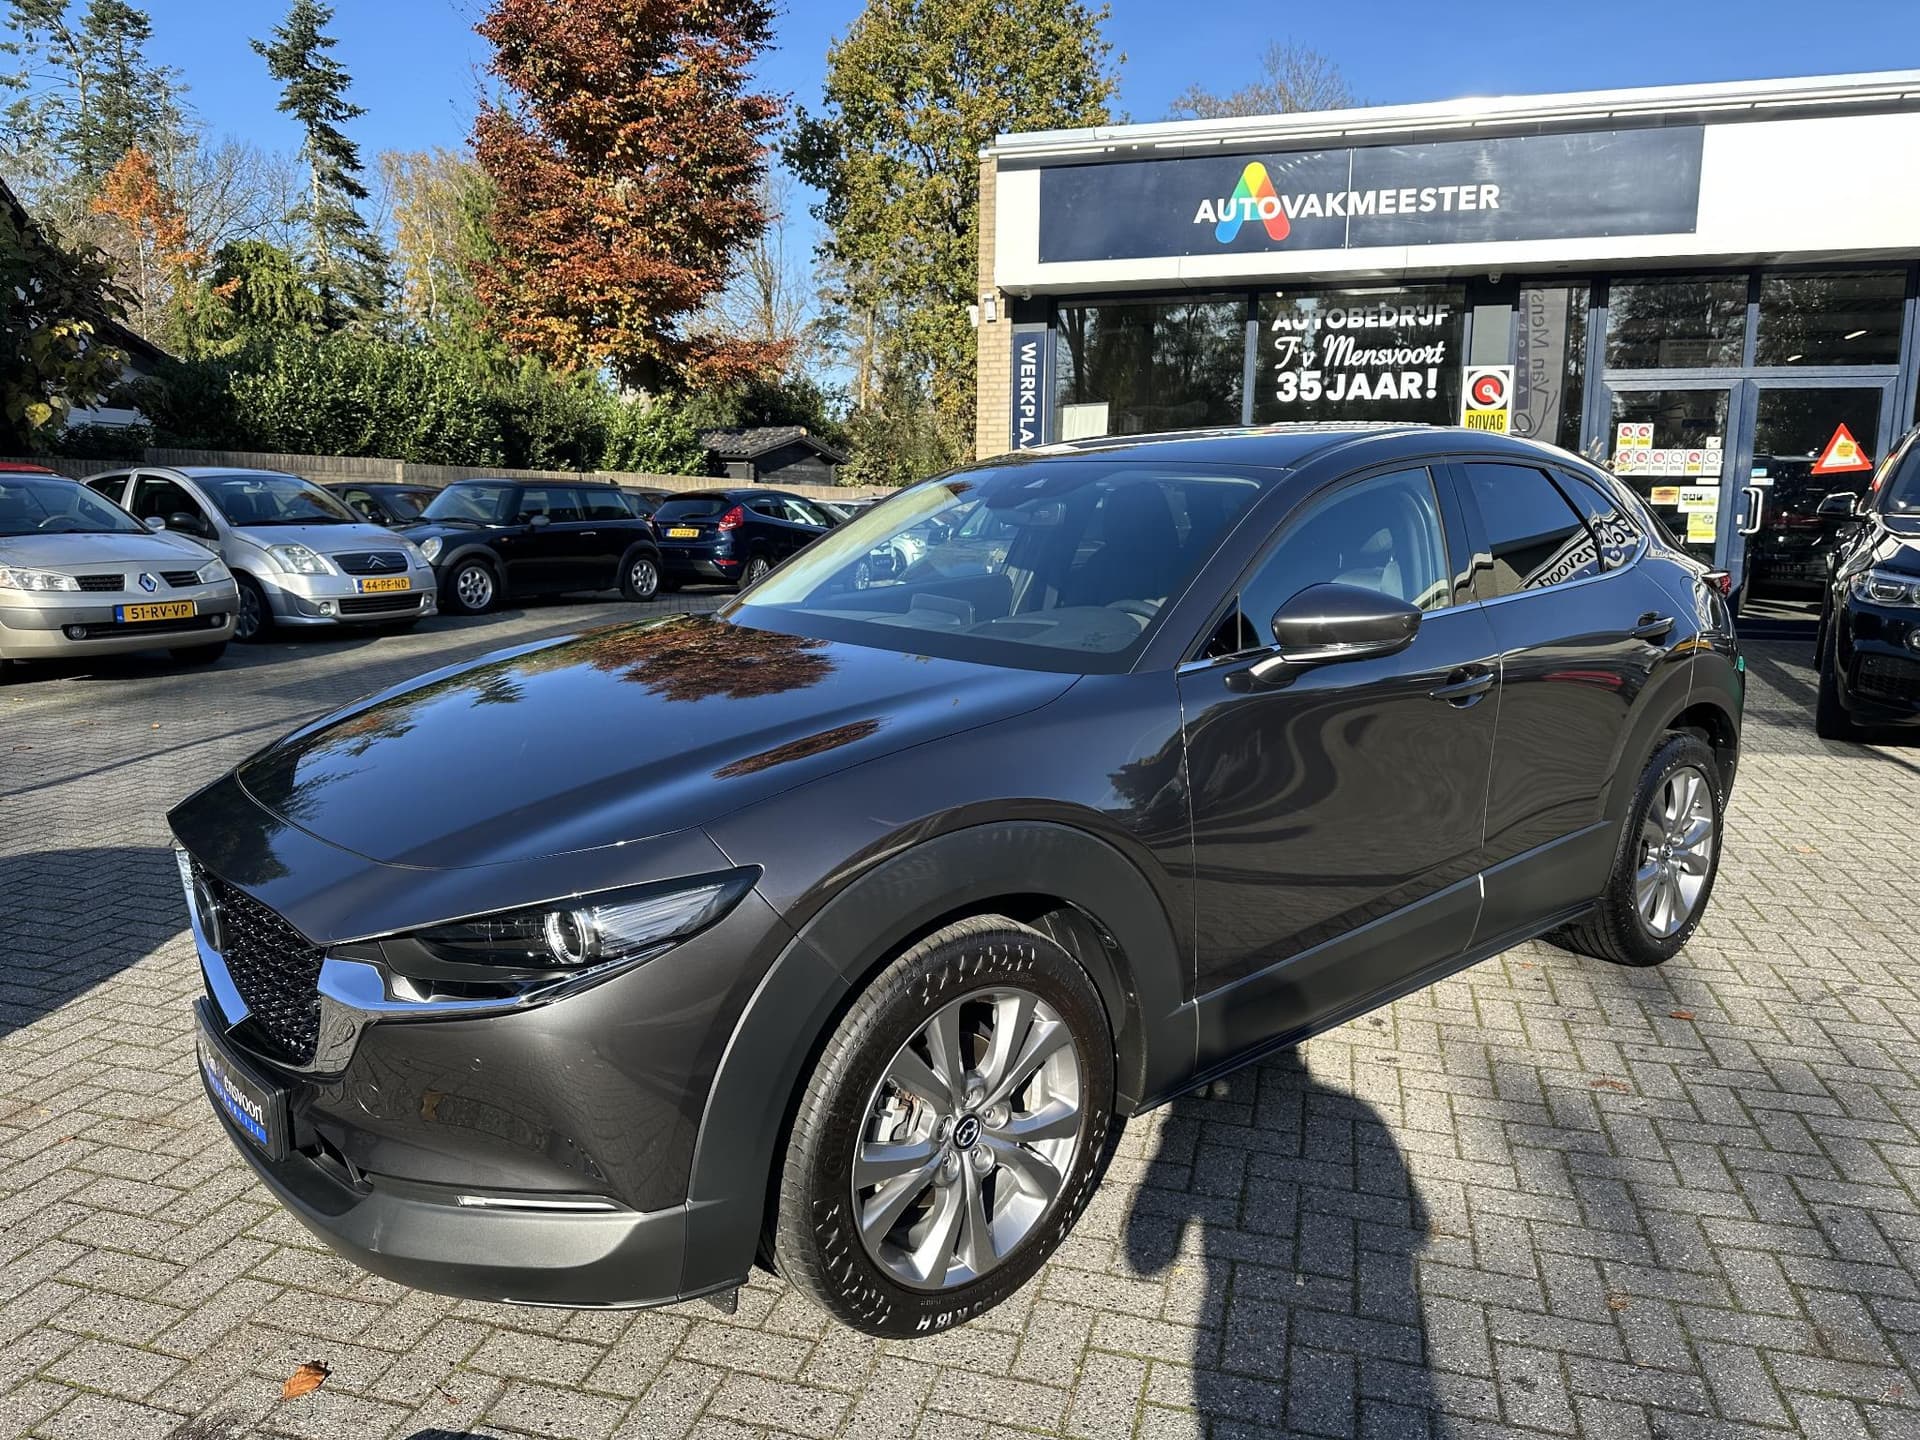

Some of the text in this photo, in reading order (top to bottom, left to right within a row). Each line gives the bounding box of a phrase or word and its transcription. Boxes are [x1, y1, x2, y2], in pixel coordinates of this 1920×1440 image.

[1193, 184, 1500, 224] AUTOVAKMEESTER
[1323, 334, 1445, 367] Mensvoort
[1020, 342, 1037, 449] WERKPLA
[1276, 368, 1438, 402] 35 JAAR!
[1468, 414, 1503, 430] BOVAG
[131, 604, 188, 619] 51-RV-VP
